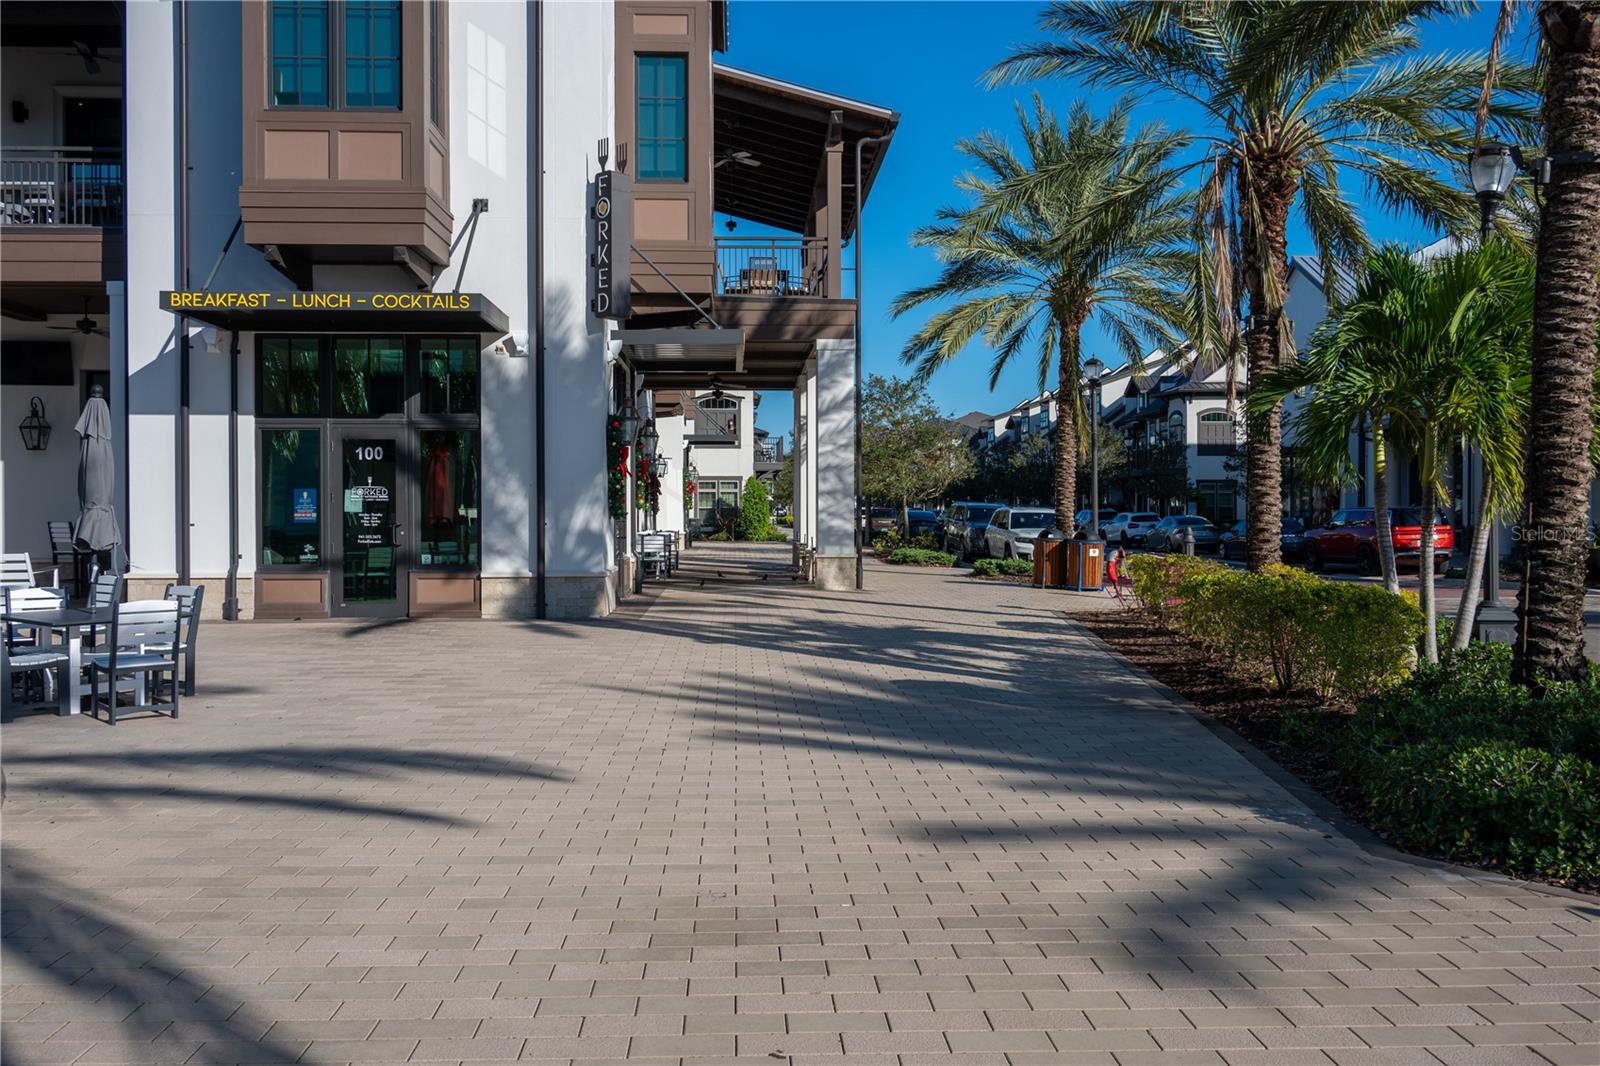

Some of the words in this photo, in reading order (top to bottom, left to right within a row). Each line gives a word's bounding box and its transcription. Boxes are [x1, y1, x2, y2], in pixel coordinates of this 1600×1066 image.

[596, 174, 611, 313] FORKED
[170, 292, 271, 307] BREAKFAST
[292, 293, 350, 308] LUNCH
[372, 294, 470, 309] COCKTAILS
[355, 446, 384, 460] 100
[351, 487, 389, 496] FORKED
